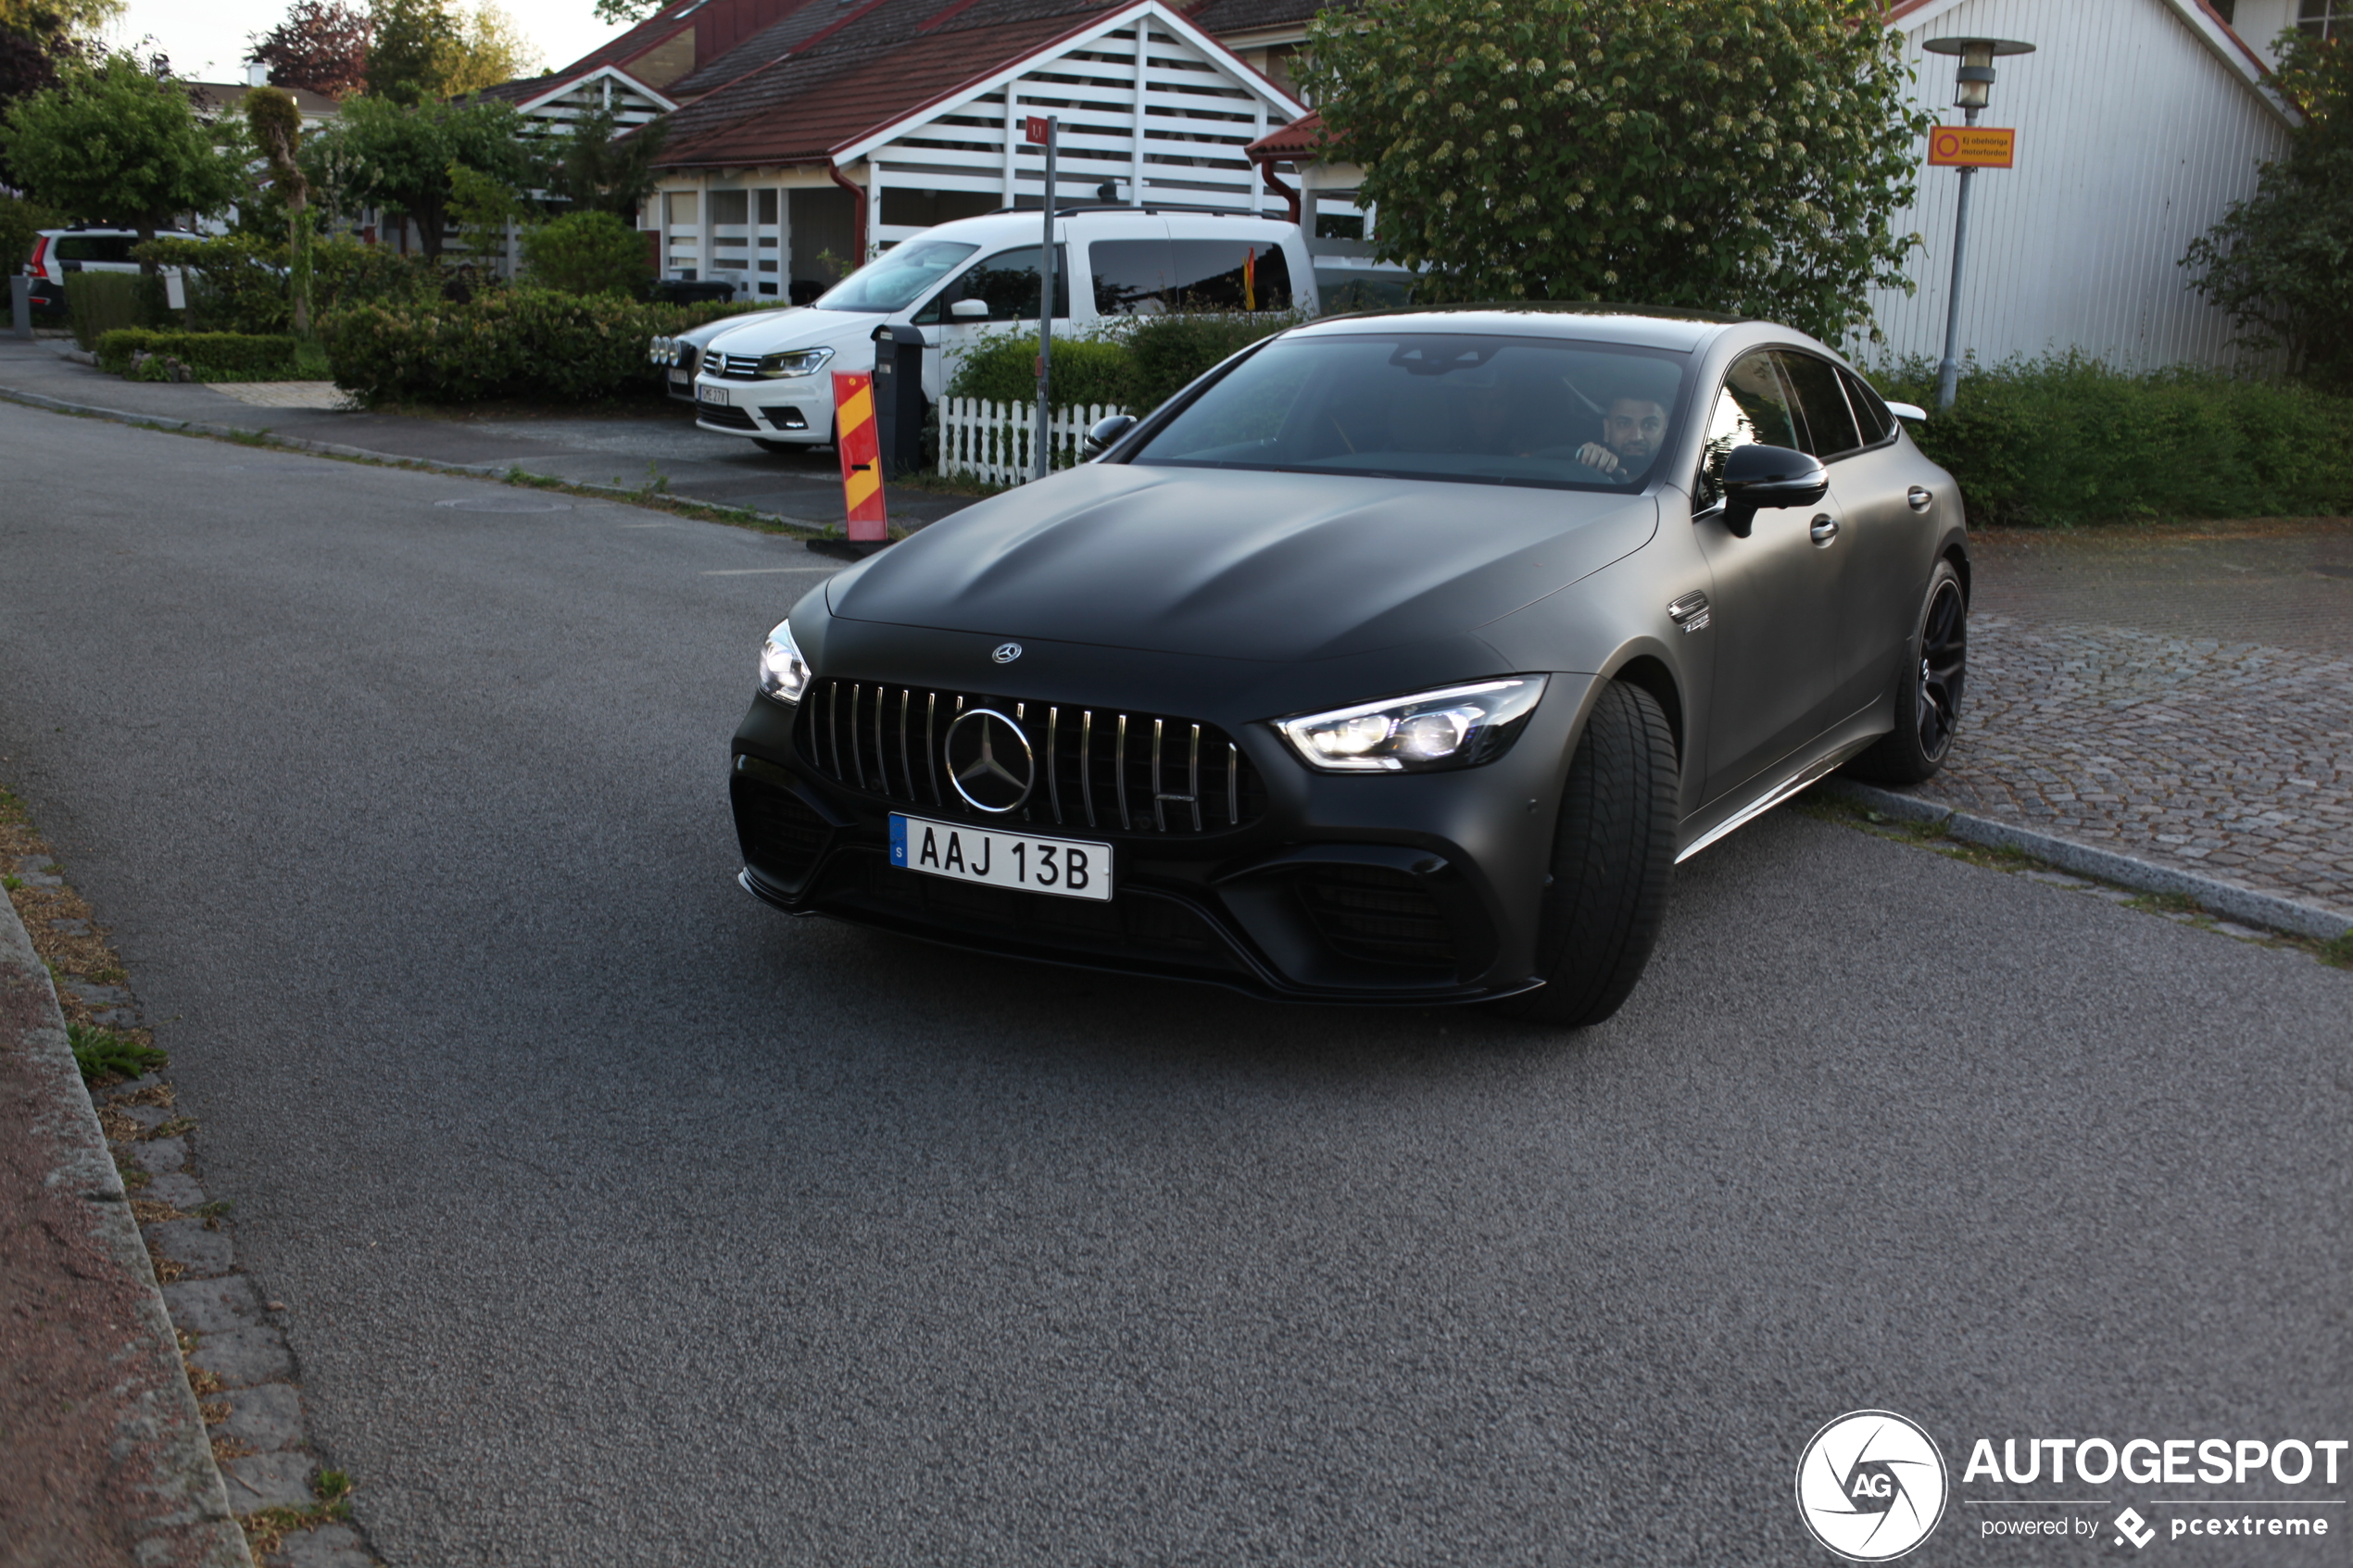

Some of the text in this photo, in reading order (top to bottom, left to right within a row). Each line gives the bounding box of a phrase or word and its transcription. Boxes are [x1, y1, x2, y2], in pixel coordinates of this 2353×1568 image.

[1962, 136, 2008, 147] Ej obehöriga
[1961, 148, 2007, 157] motorfordon
[895, 826, 1089, 890] S AAJ 13B
